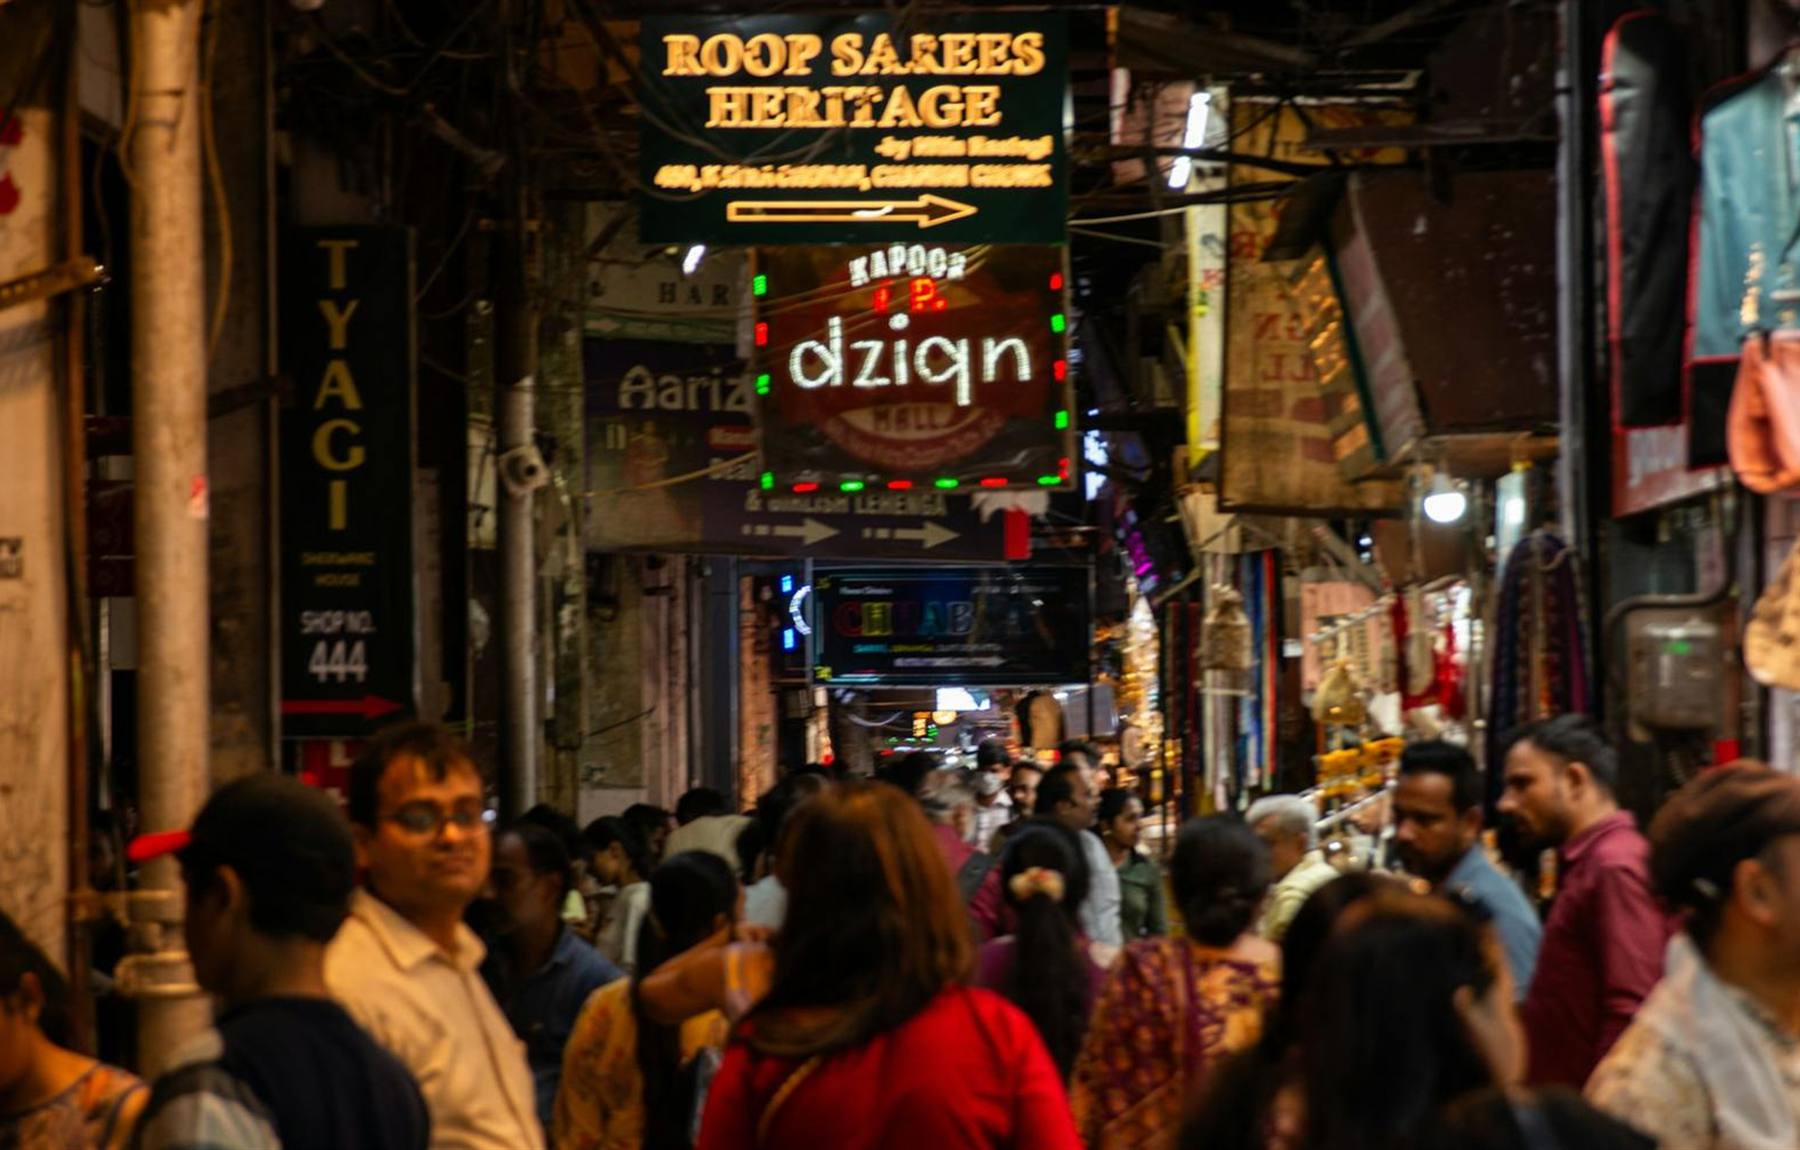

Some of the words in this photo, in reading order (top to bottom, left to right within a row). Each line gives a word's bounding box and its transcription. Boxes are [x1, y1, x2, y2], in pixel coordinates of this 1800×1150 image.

[662, 33, 822, 77] ROOP
[831, 32, 1046, 76] SAREES
[705, 84, 1003, 128] HERITAGE
[849, 244, 967, 288] KAPOOR
[311, 239, 366, 530] TYAGI
[618, 364, 752, 412] Aariz
[308, 640, 369, 683] 444
